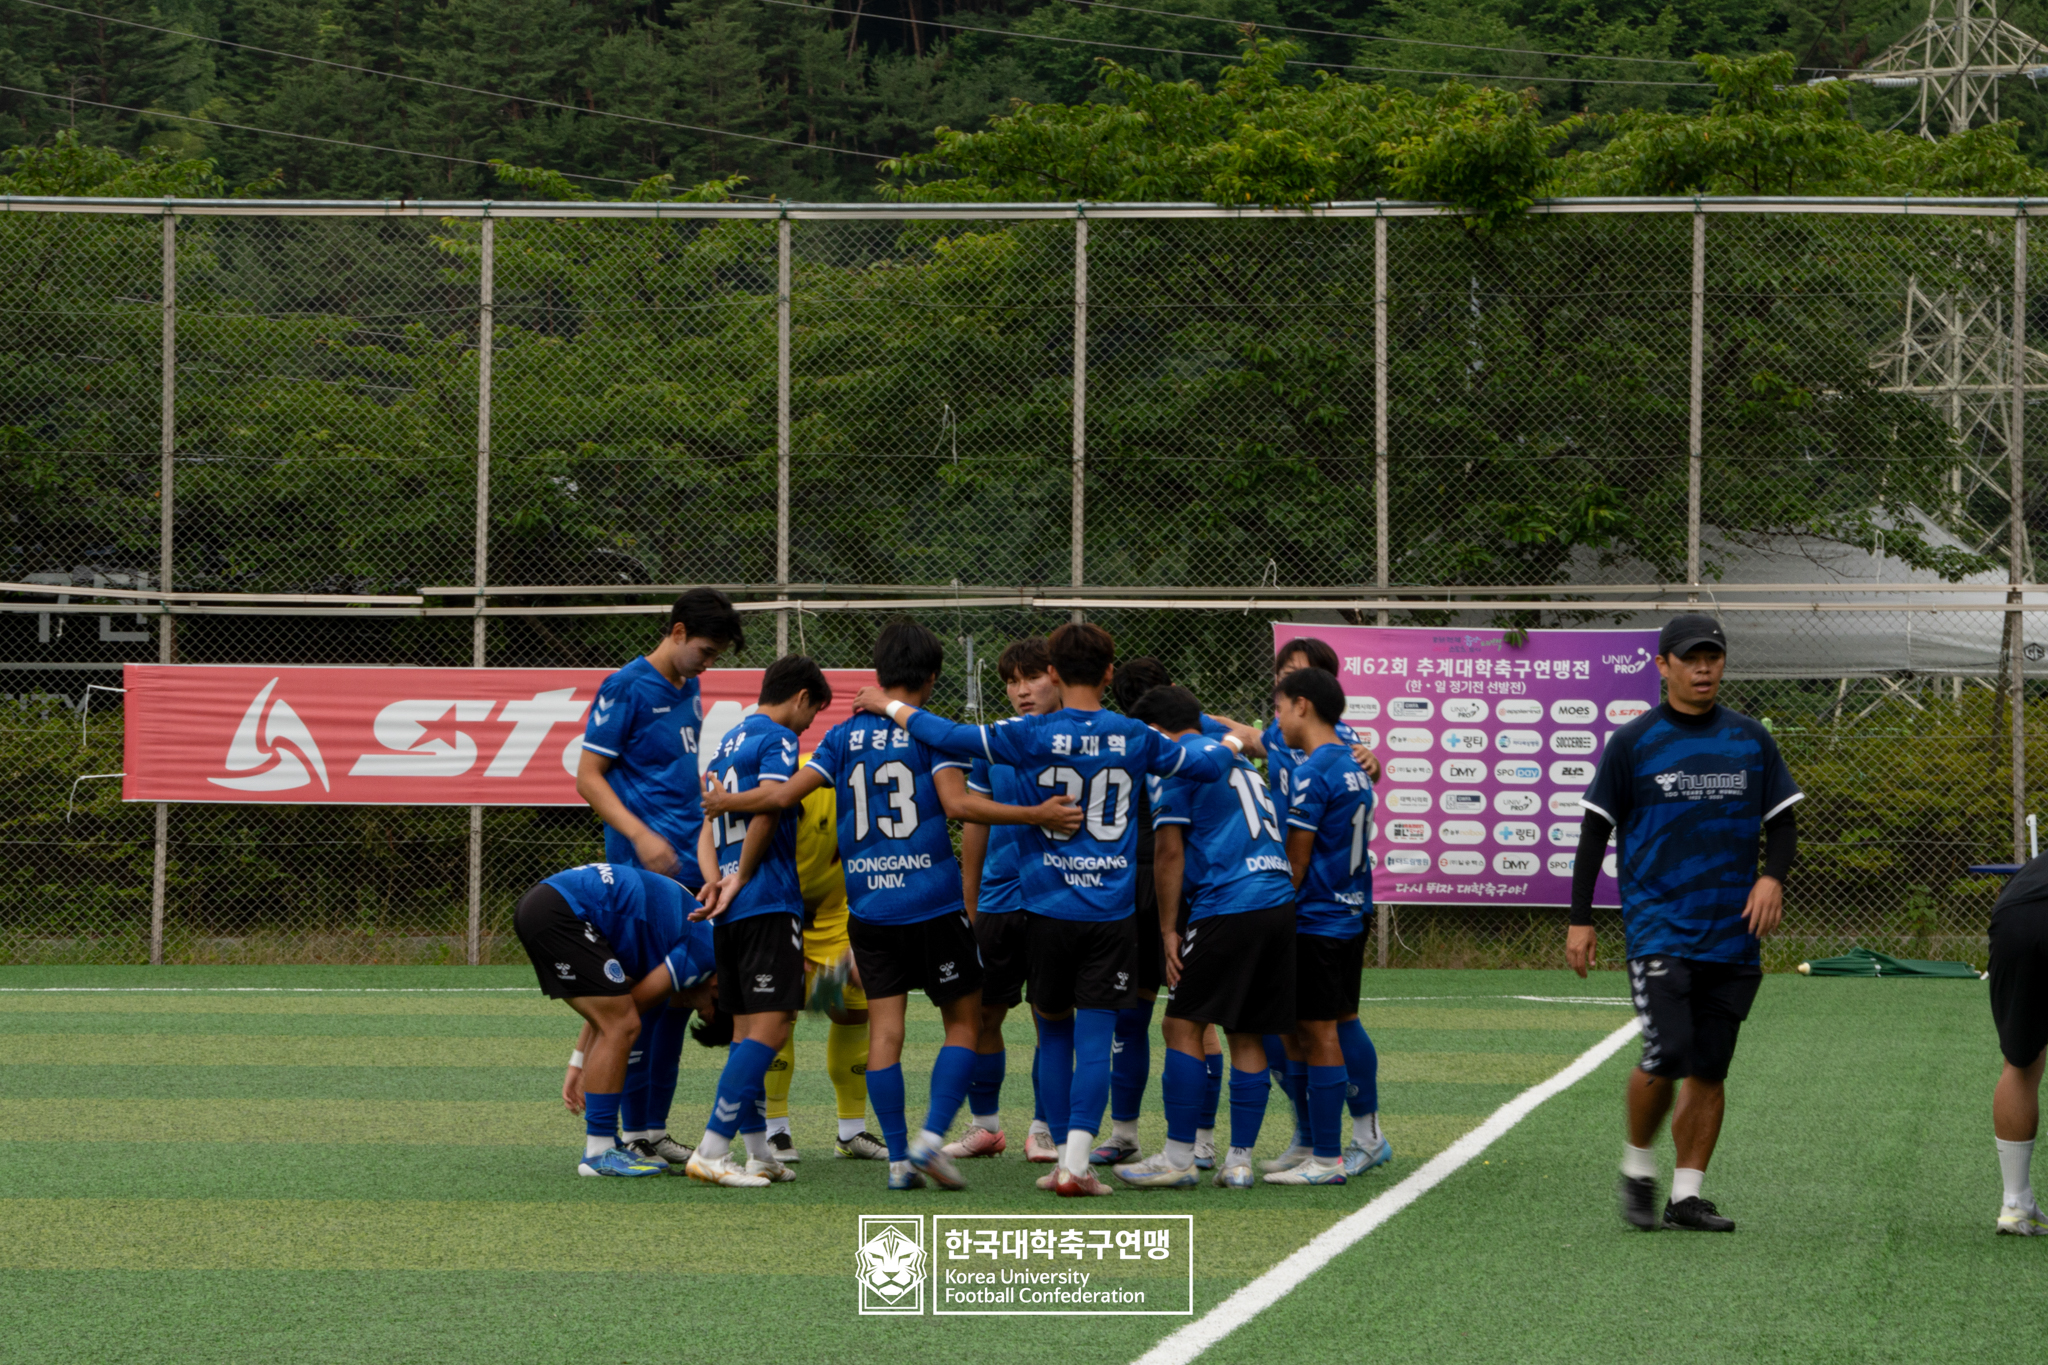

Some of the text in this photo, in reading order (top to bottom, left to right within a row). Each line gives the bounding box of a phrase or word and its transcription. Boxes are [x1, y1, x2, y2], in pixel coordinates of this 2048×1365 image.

[1602, 655, 1632, 664] UNIV
[1343, 656, 1590, 680] 제62회 추계대학축구연맹전
[1614, 664, 1637, 674] PRO
[1449, 680, 1484, 694] 정기전
[1487, 681, 1526, 695] 선발전)
[679, 726, 698, 754] 19
[1463, 735, 1483, 748] 링티
[1450, 767, 1477, 777] DMY
[1517, 768, 1538, 778] pay
[1677, 769, 1747, 790] hummel
[1279, 767, 1289, 796] 8
[847, 759, 920, 843] 13
[1516, 828, 1536, 841] 링티
[847, 853, 932, 874] DONGGANG
[1043, 852, 1128, 871] DONGGANG
[1502, 860, 1529, 870] DMY
[867, 873, 905, 890] UNIV.
[1064, 872, 1104, 888] UNIV.
[1395, 883, 1422, 894] 다시
[1457, 883, 1528, 897] 대학축구야!
[939, 972, 959, 984] hummel
